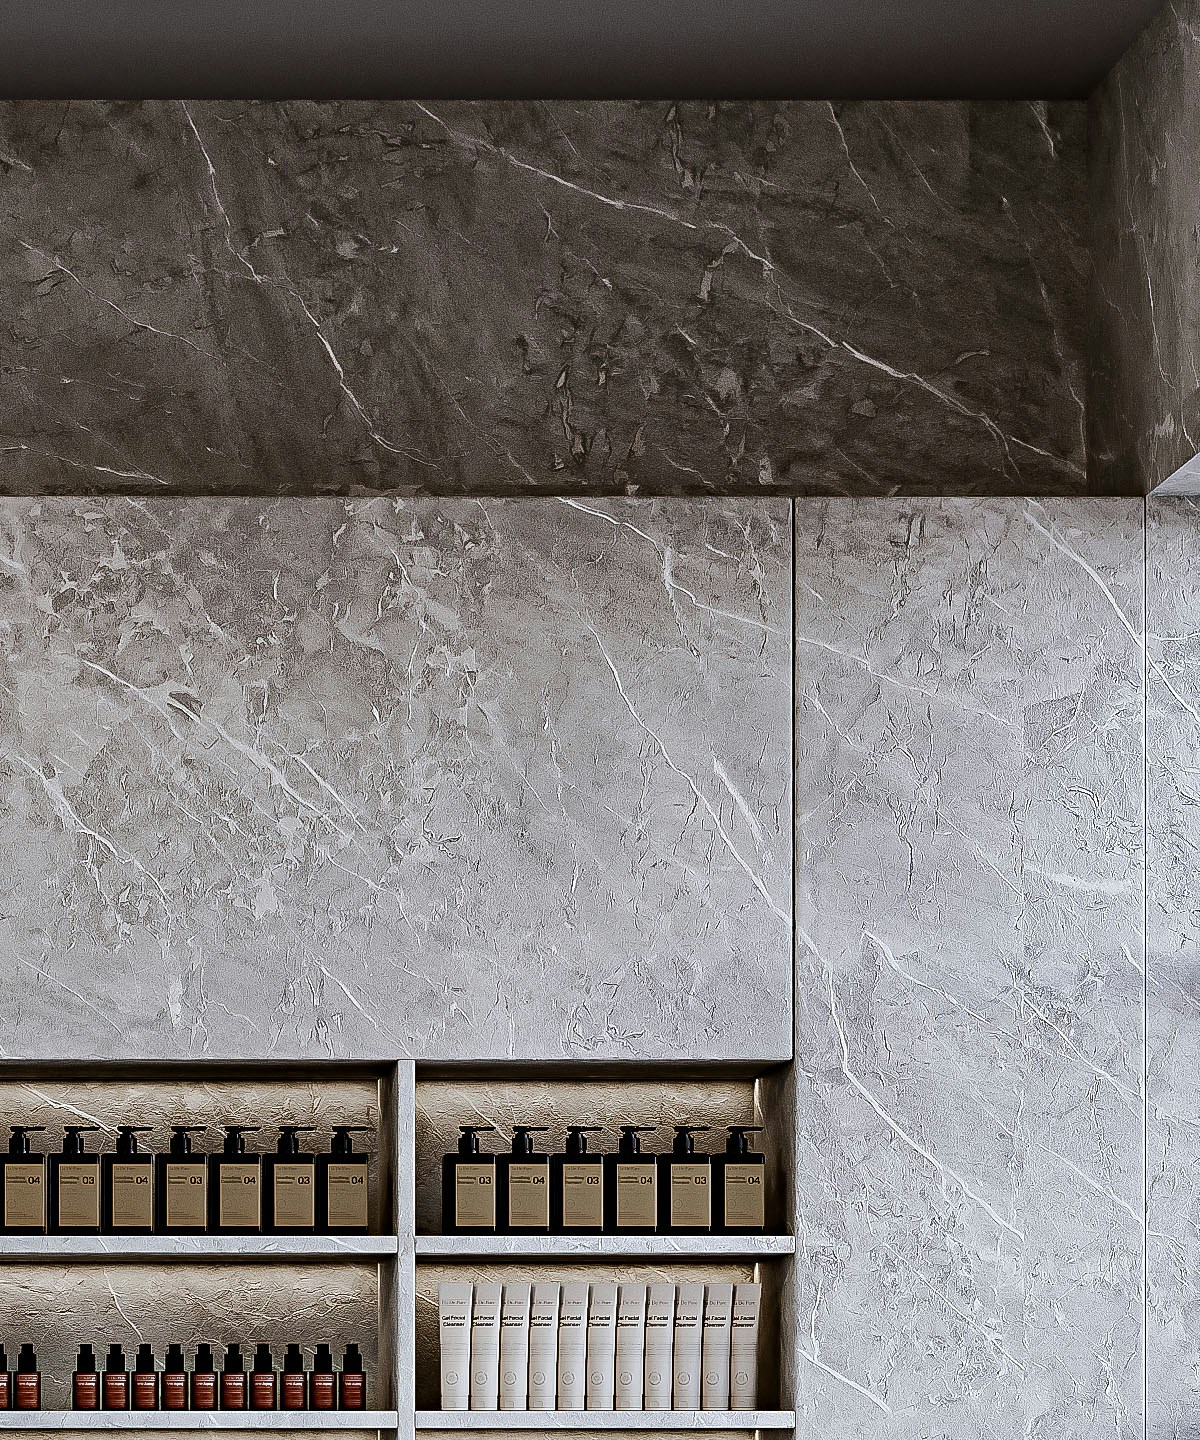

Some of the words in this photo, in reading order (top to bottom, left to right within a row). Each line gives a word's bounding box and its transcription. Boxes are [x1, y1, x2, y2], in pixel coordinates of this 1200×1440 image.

[28, 1176, 40, 1185] 04
[82, 1176, 94, 1185] 03
[136, 1176, 148, 1185] 04
[190, 1176, 202, 1185] 03
[243, 1176, 256, 1185] 04
[298, 1176, 310, 1185] 03
[351, 1176, 364, 1185] 04
[479, 1176, 492, 1185] 03
[532, 1176, 545, 1185] 04
[586, 1176, 599, 1185] 03
[640, 1176, 653, 1185] 04
[694, 1176, 707, 1185] 03
[748, 1176, 760, 1185] 04
